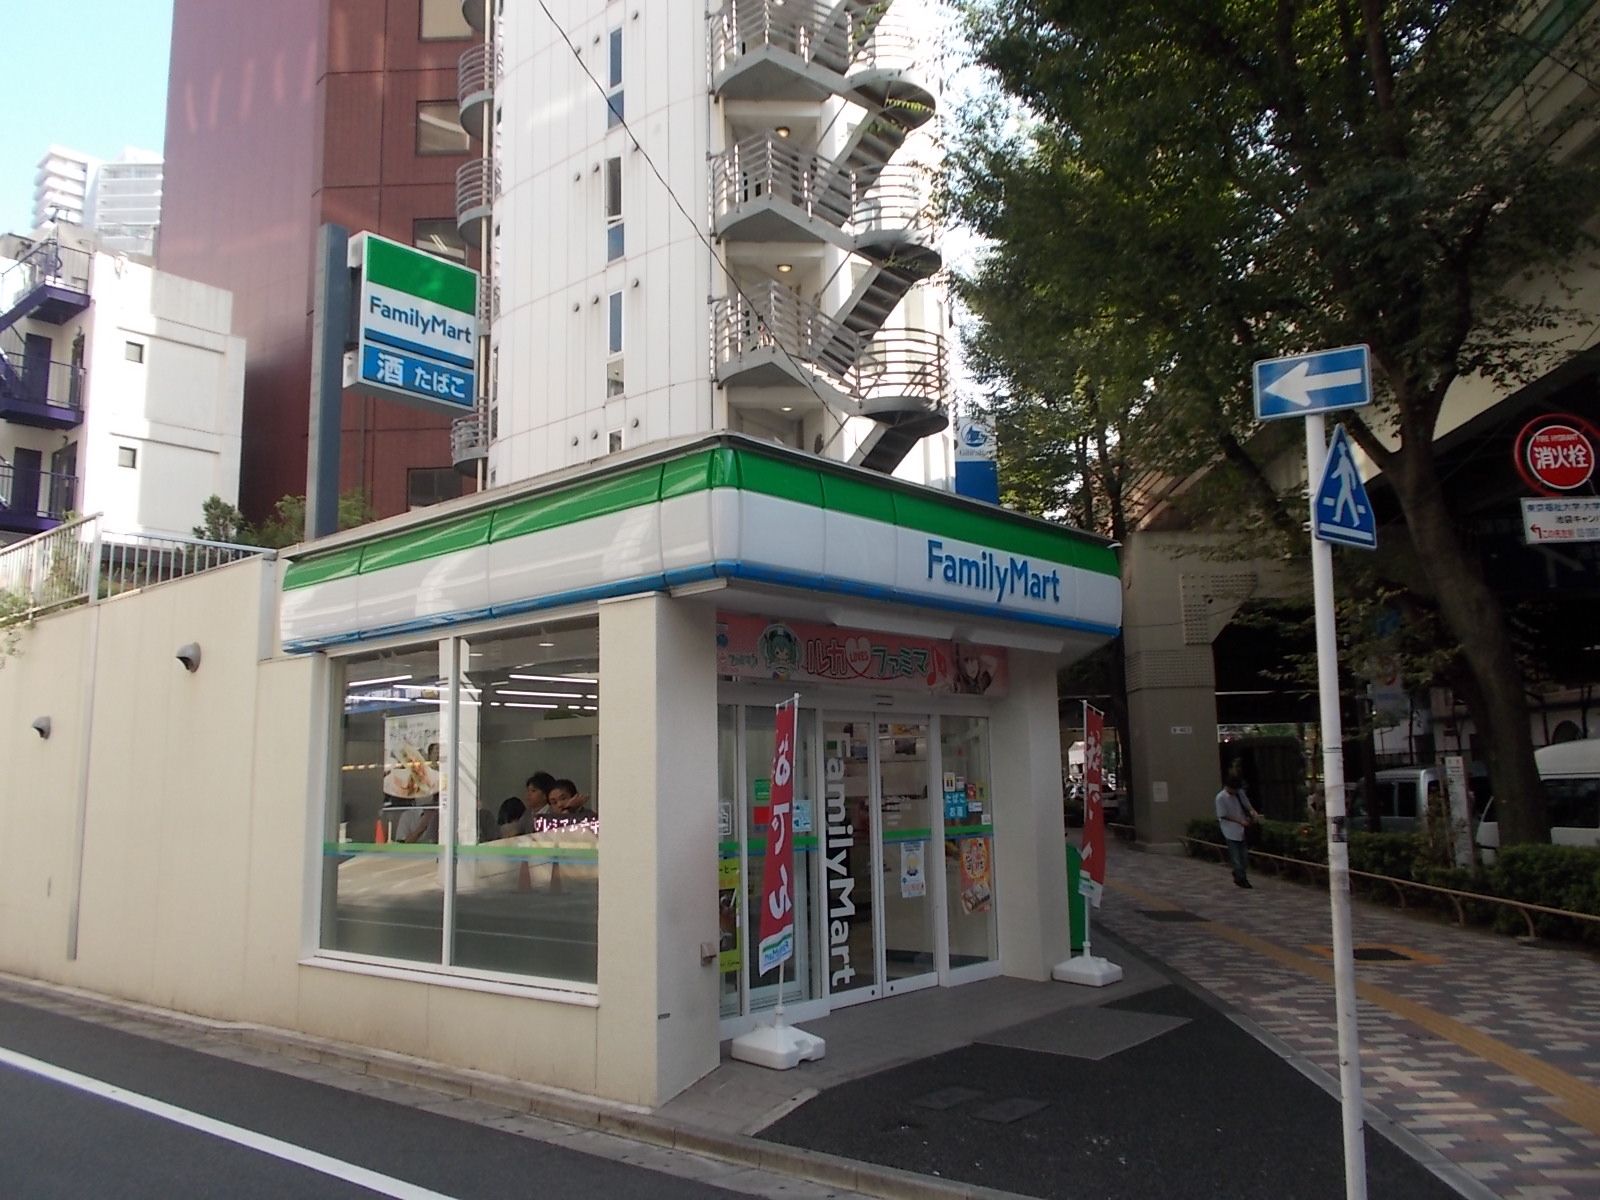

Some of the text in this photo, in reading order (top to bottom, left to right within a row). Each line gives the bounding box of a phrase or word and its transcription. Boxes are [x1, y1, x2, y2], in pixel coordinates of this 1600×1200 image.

[370, 296, 472, 344] FamilyMart
[377, 352, 465, 398] 酒 たばこ
[1533, 444, 1589, 470] 消火栓
[927, 539, 1060, 602] FamilyMart
[807, 637, 848, 676] ルカ
[871, 645, 929, 678] ファミマ
[945, 793, 966, 804] たばこ
[826, 732, 856, 986] FamilyMart
